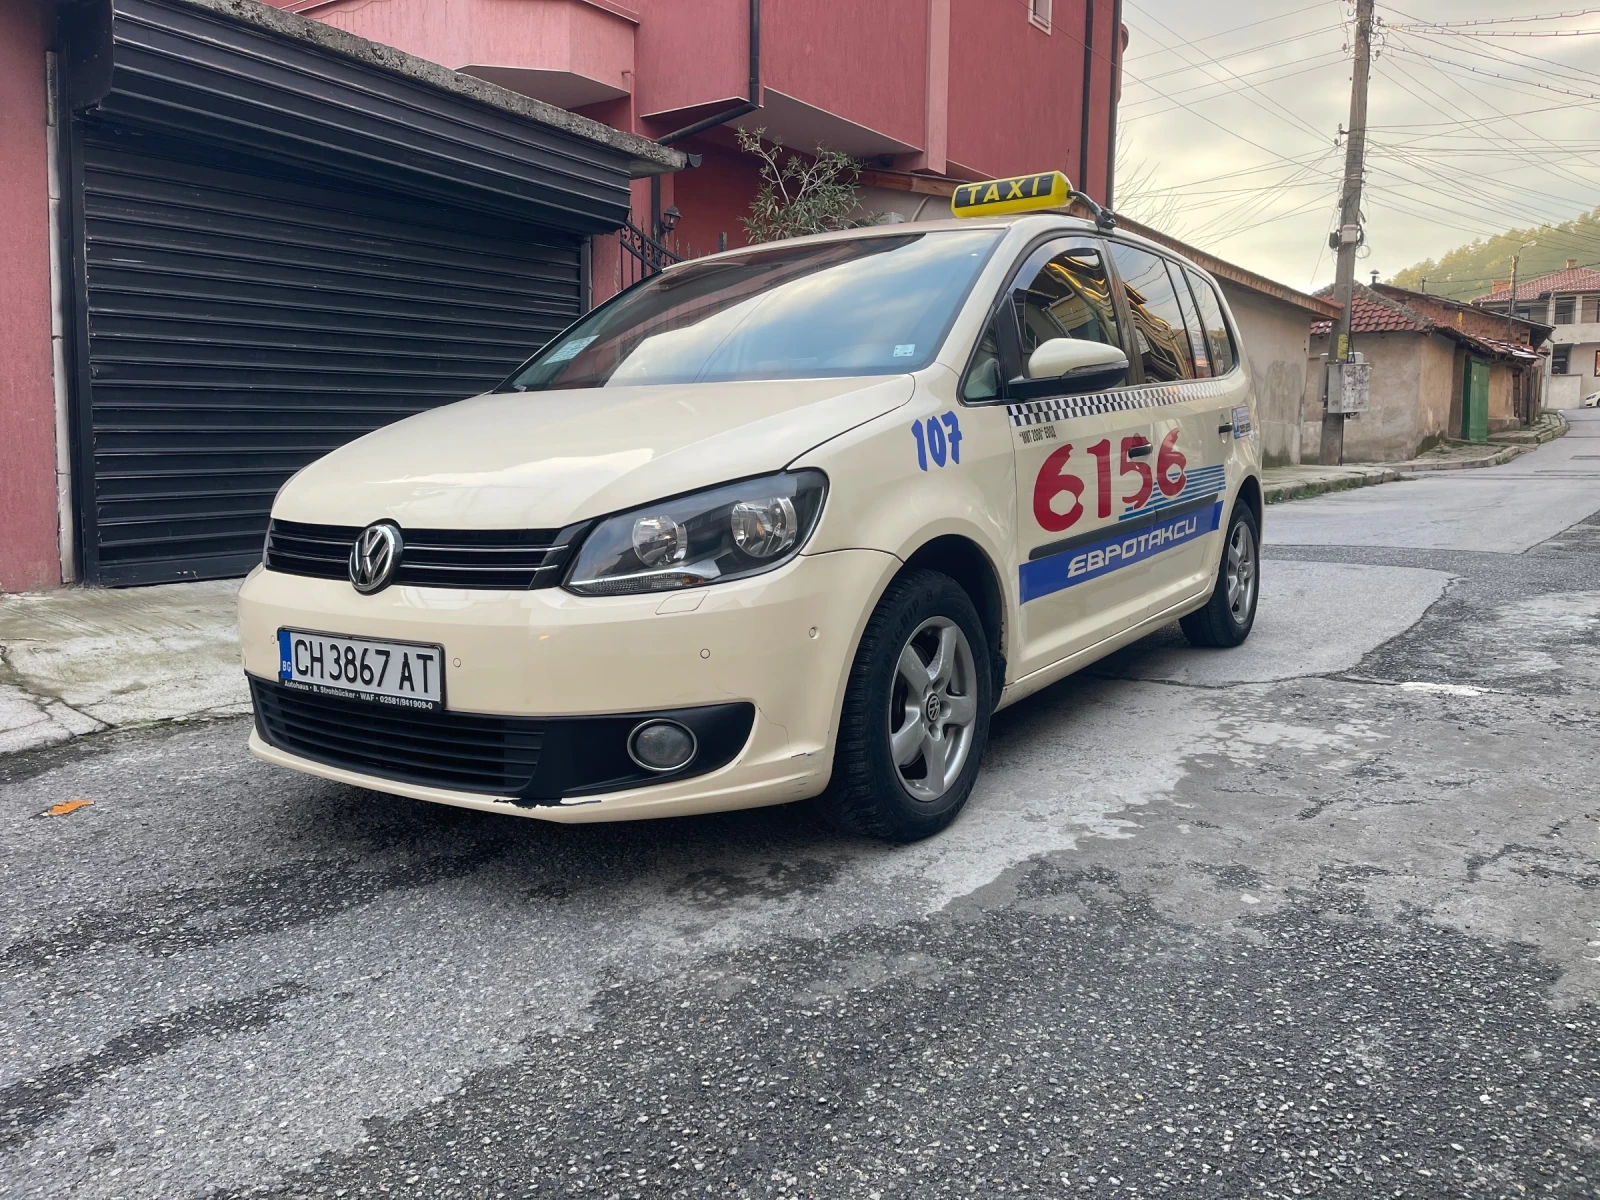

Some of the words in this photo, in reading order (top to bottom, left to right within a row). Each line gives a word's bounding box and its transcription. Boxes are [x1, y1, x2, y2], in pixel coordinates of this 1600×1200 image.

[968, 177, 1040, 205] TAXI
[911, 410, 962, 472] 107
[1033, 427, 1187, 532] 6156
[282, 660, 292, 673] BG
[329, 643, 391, 688] 3867
[399, 651, 434, 694] AT
[284, 680, 309, 691] Autohaus
[360, 692, 375, 702] WAF
